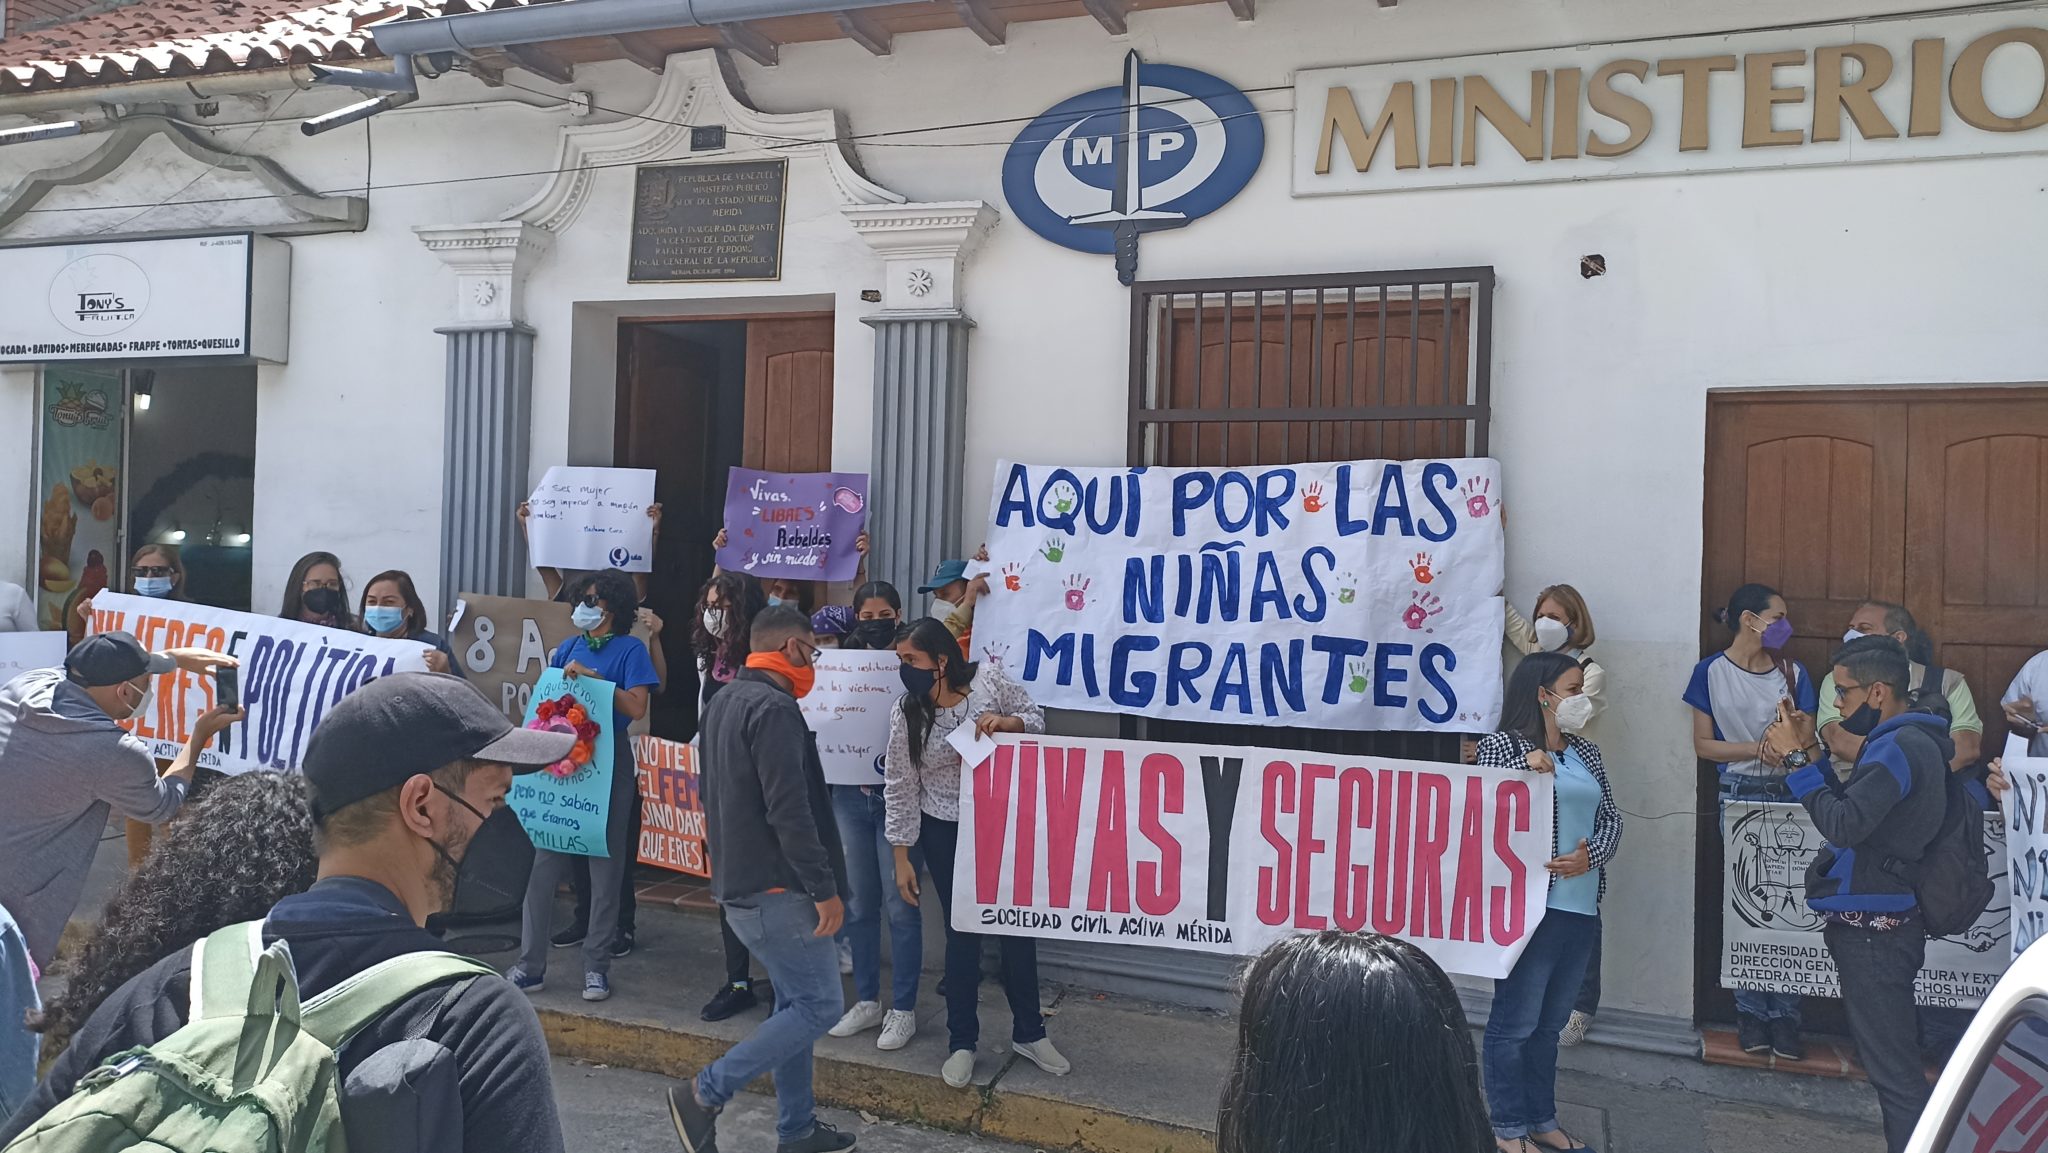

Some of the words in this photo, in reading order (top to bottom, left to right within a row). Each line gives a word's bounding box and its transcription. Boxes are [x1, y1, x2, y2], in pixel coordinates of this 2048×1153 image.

[1314, 27, 2048, 176] MINISTERIO
[738, 223, 776, 232] DURANTE
[0, 344, 26, 354] OCADA
[1172, 468, 1297, 537] POR
[1335, 462, 1459, 542] LAS
[776, 526, 832, 548] Rebeldes
[744, 552, 760, 570] y
[762, 551, 782, 564] sin
[785, 548, 819, 566] miedo
[1122, 539, 1336, 624] NIÑAS
[465, 614, 496, 673] 8
[1022, 628, 1459, 723] MIGRANTES
[636, 736, 659, 767] NO
[660, 738, 686, 771] TE
[514, 784, 536, 800] pero
[538, 790, 555, 803] no
[638, 768, 660, 800] EL
[520, 808, 536, 826] que
[642, 800, 674, 832] SINO
[526, 828, 589, 853] EMILLAS
[640, 830, 664, 862] QUE
[668, 835, 702, 871] ERES
[1199, 756, 1244, 922] Y
[1256, 760, 1531, 947] SEGURAS
[1119, 914, 1166, 939] ACTIVA
[1176, 917, 1233, 944] MÉRIDA
[1730, 942, 1818, 958] UNIVERSIDAD
[1822, 948, 1830, 958] D
[1794, 972, 1812, 984] DE
[1816, 974, 1834, 985] LA
[1914, 982, 1952, 995] CHOS
[1955, 984, 1988, 998] HUM
[1961, 972, 1969, 982] Y
[1973, 972, 2000, 985] EXT
